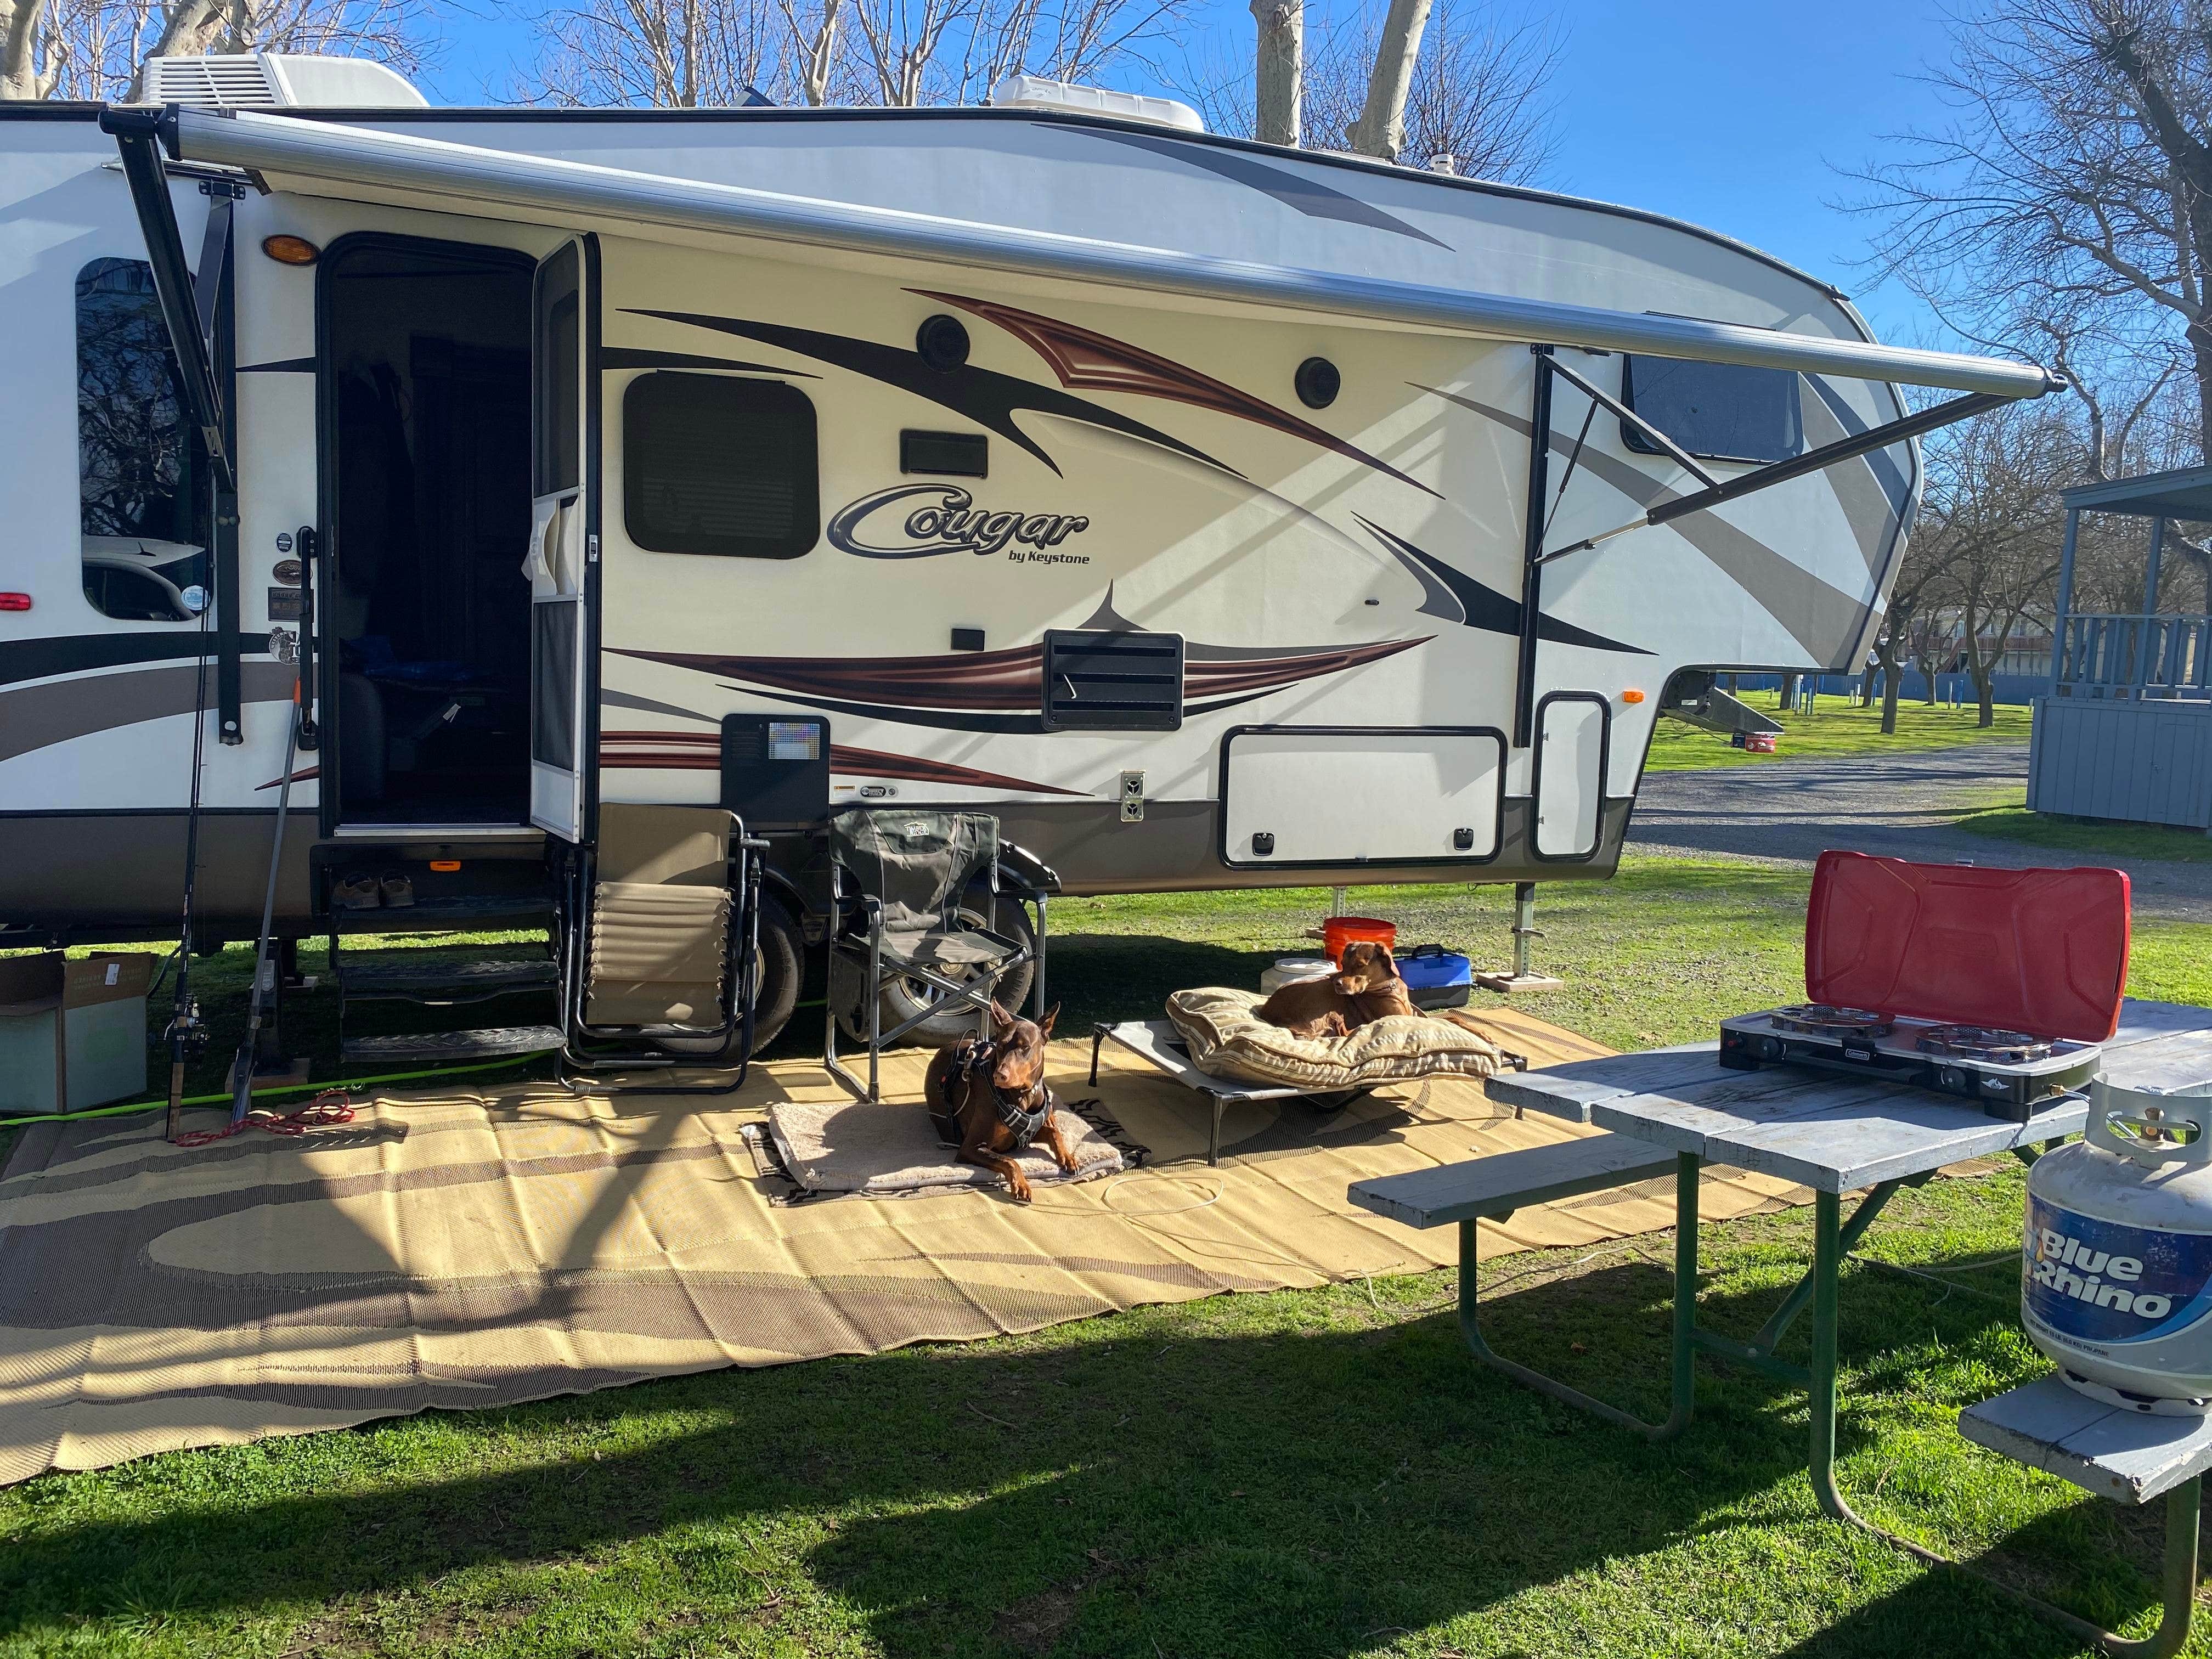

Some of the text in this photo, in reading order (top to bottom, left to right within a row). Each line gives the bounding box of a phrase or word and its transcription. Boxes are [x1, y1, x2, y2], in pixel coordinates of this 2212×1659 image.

[827, 483, 1089, 559] Cougar
[1008, 550, 1090, 565] by Keystone
[2042, 1228, 2143, 1282] Blue
[2034, 1260, 2172, 1319] Rhino
